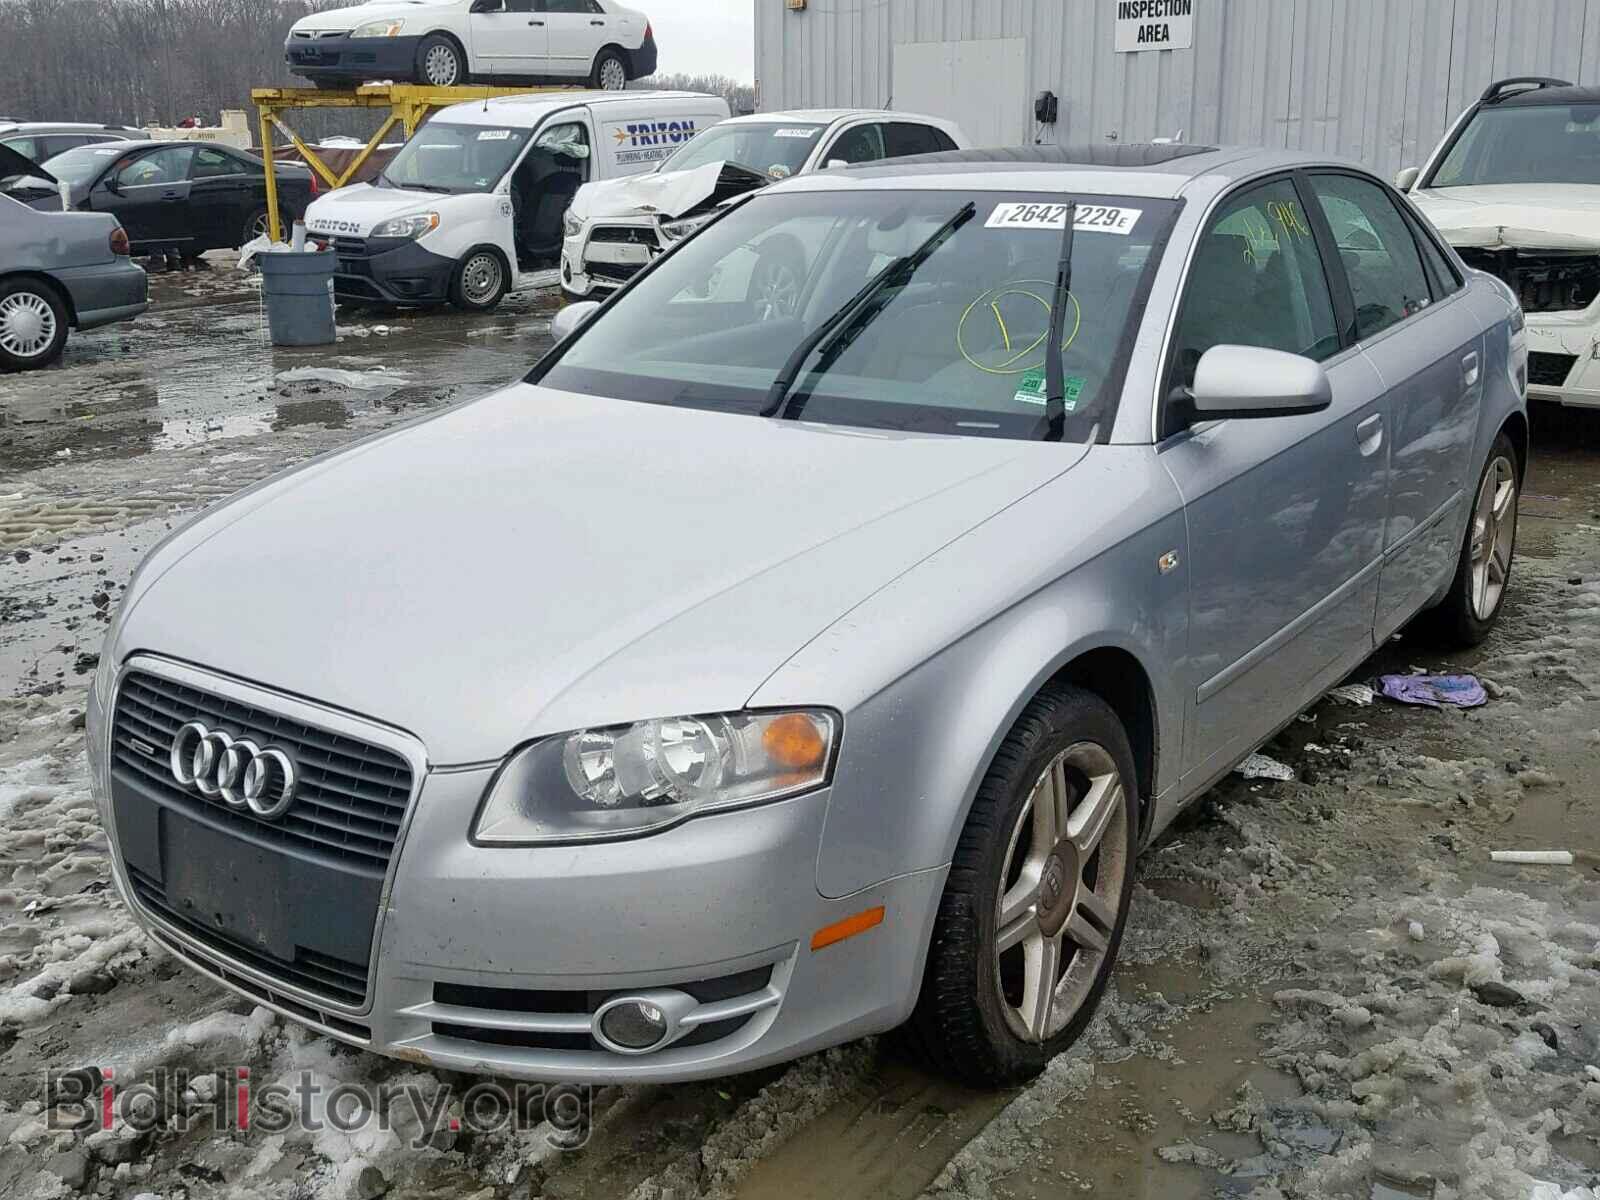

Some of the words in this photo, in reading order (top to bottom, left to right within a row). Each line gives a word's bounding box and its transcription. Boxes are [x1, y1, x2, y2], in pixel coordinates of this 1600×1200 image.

[1118, 0, 1191, 19] INSPECTION
[1137, 24, 1169, 43] AREA
[627, 120, 695, 146] TRITON
[314, 219, 360, 233] TRITON
